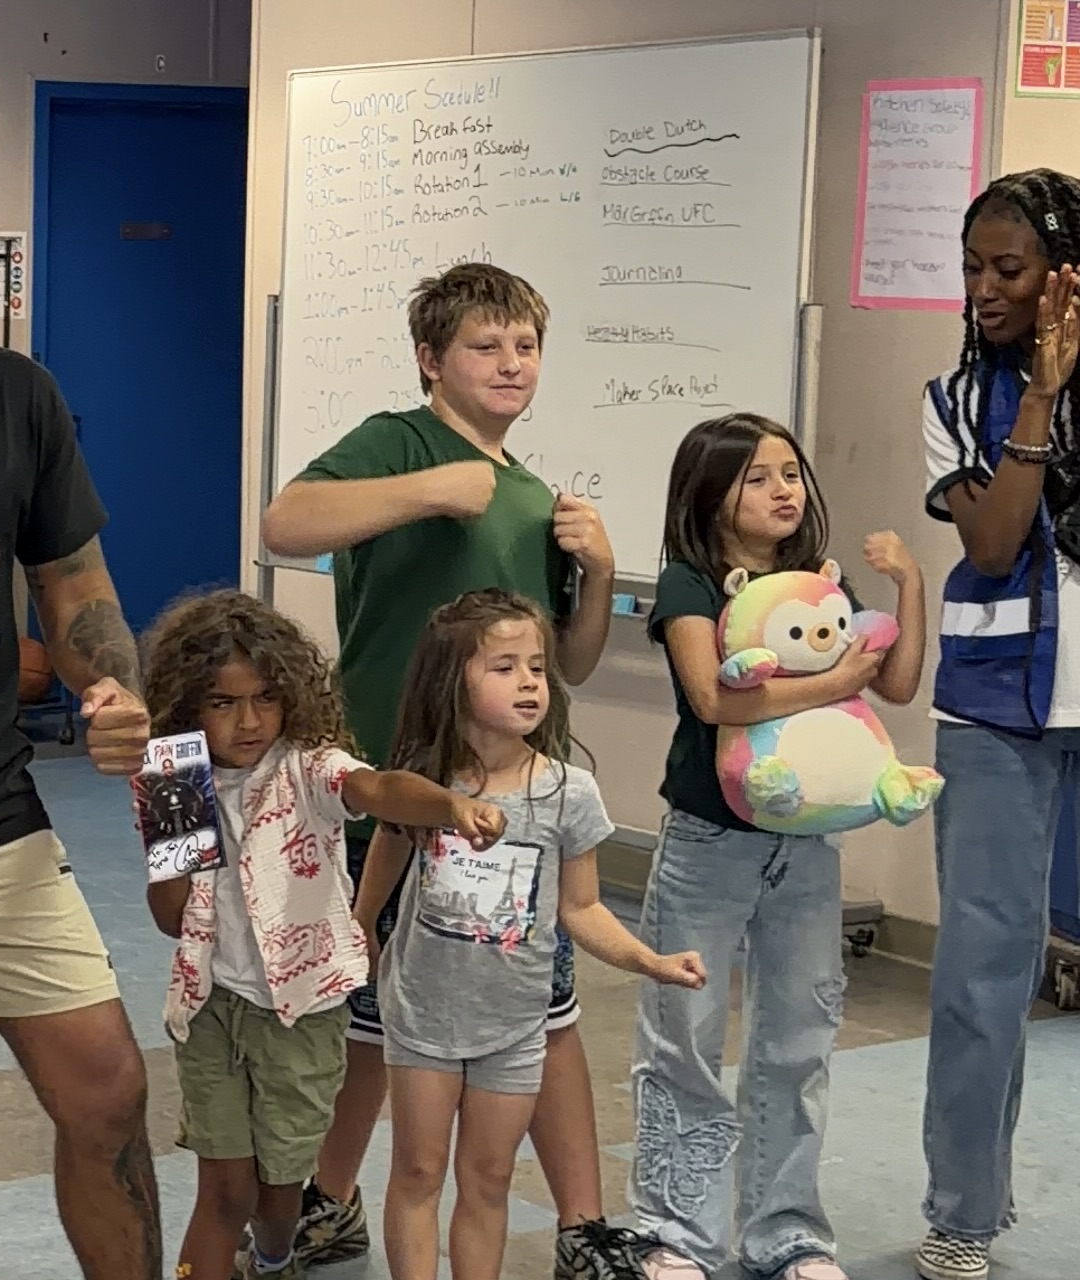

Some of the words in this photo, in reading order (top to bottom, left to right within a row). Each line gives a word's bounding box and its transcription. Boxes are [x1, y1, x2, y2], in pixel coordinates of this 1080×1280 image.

[331, 80, 416, 128] Summer
[610, 126, 656, 144] Double
[664, 119, 706, 138] Dutch
[412, 148, 468, 170] Morning
[664, 165, 710, 182] Course
[682, 203, 716, 223] UFC
[452, 857, 466, 867] JE
